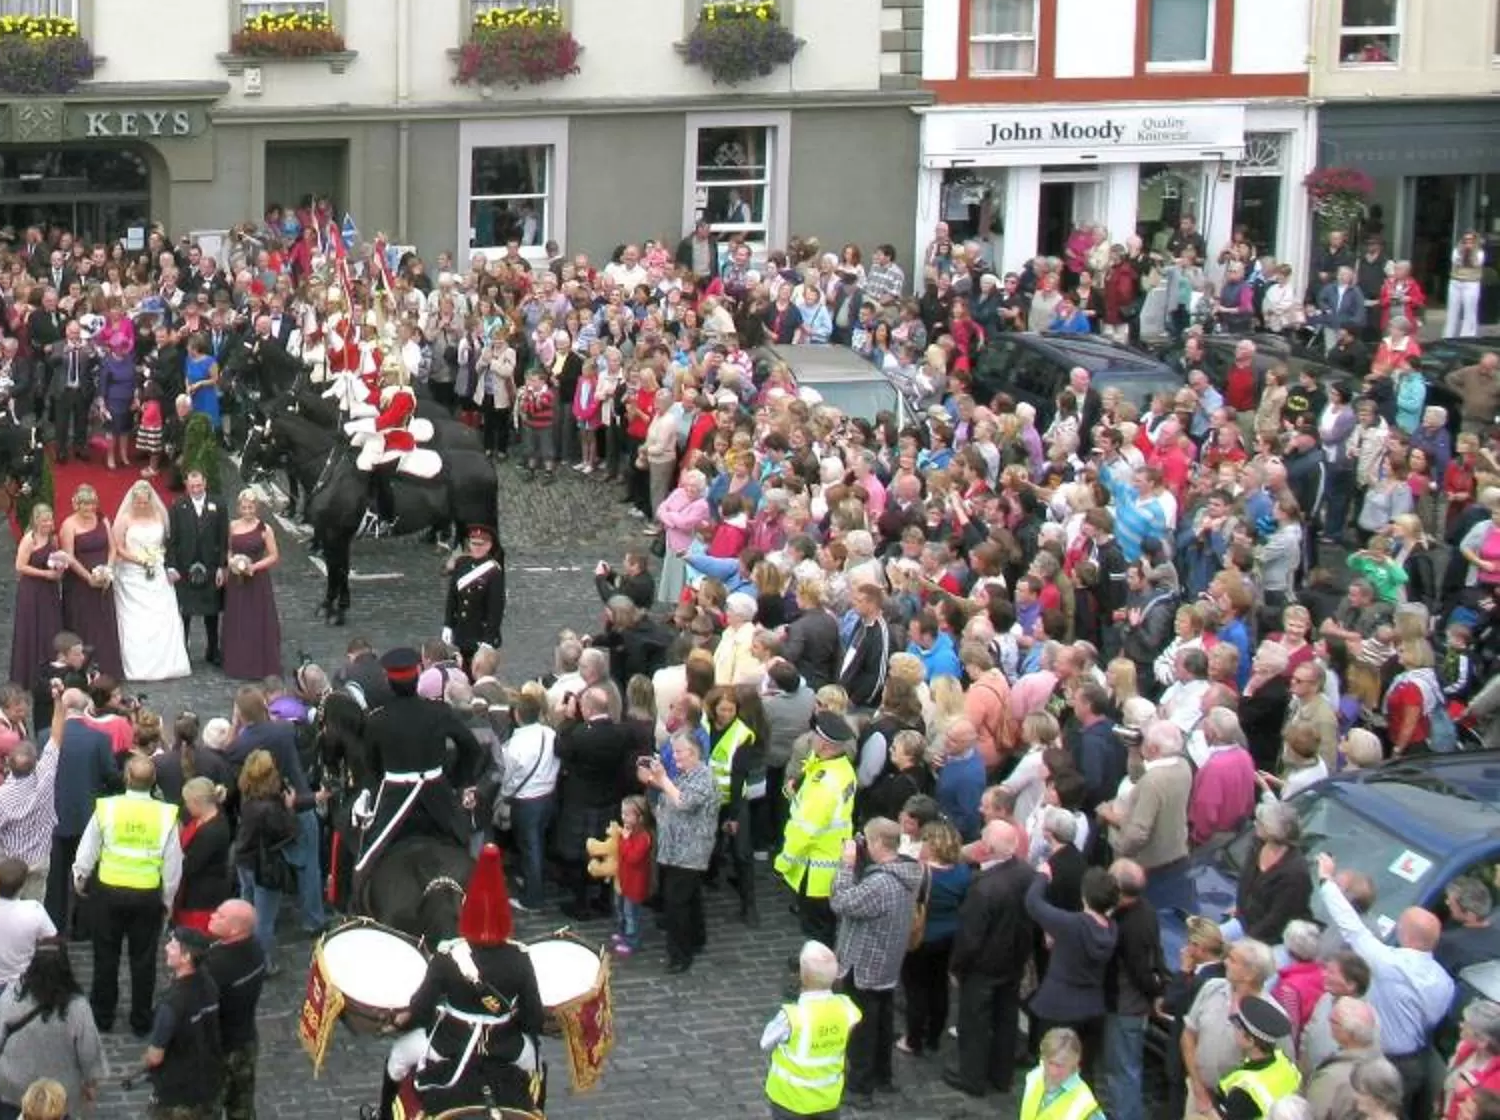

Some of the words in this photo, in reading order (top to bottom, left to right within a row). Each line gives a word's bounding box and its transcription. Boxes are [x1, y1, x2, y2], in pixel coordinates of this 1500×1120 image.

[85, 110, 190, 137] KEYS
[986, 122, 1042, 145] John
[1050, 120, 1126, 143] Moody
[1142, 116, 1186, 131] Quality
